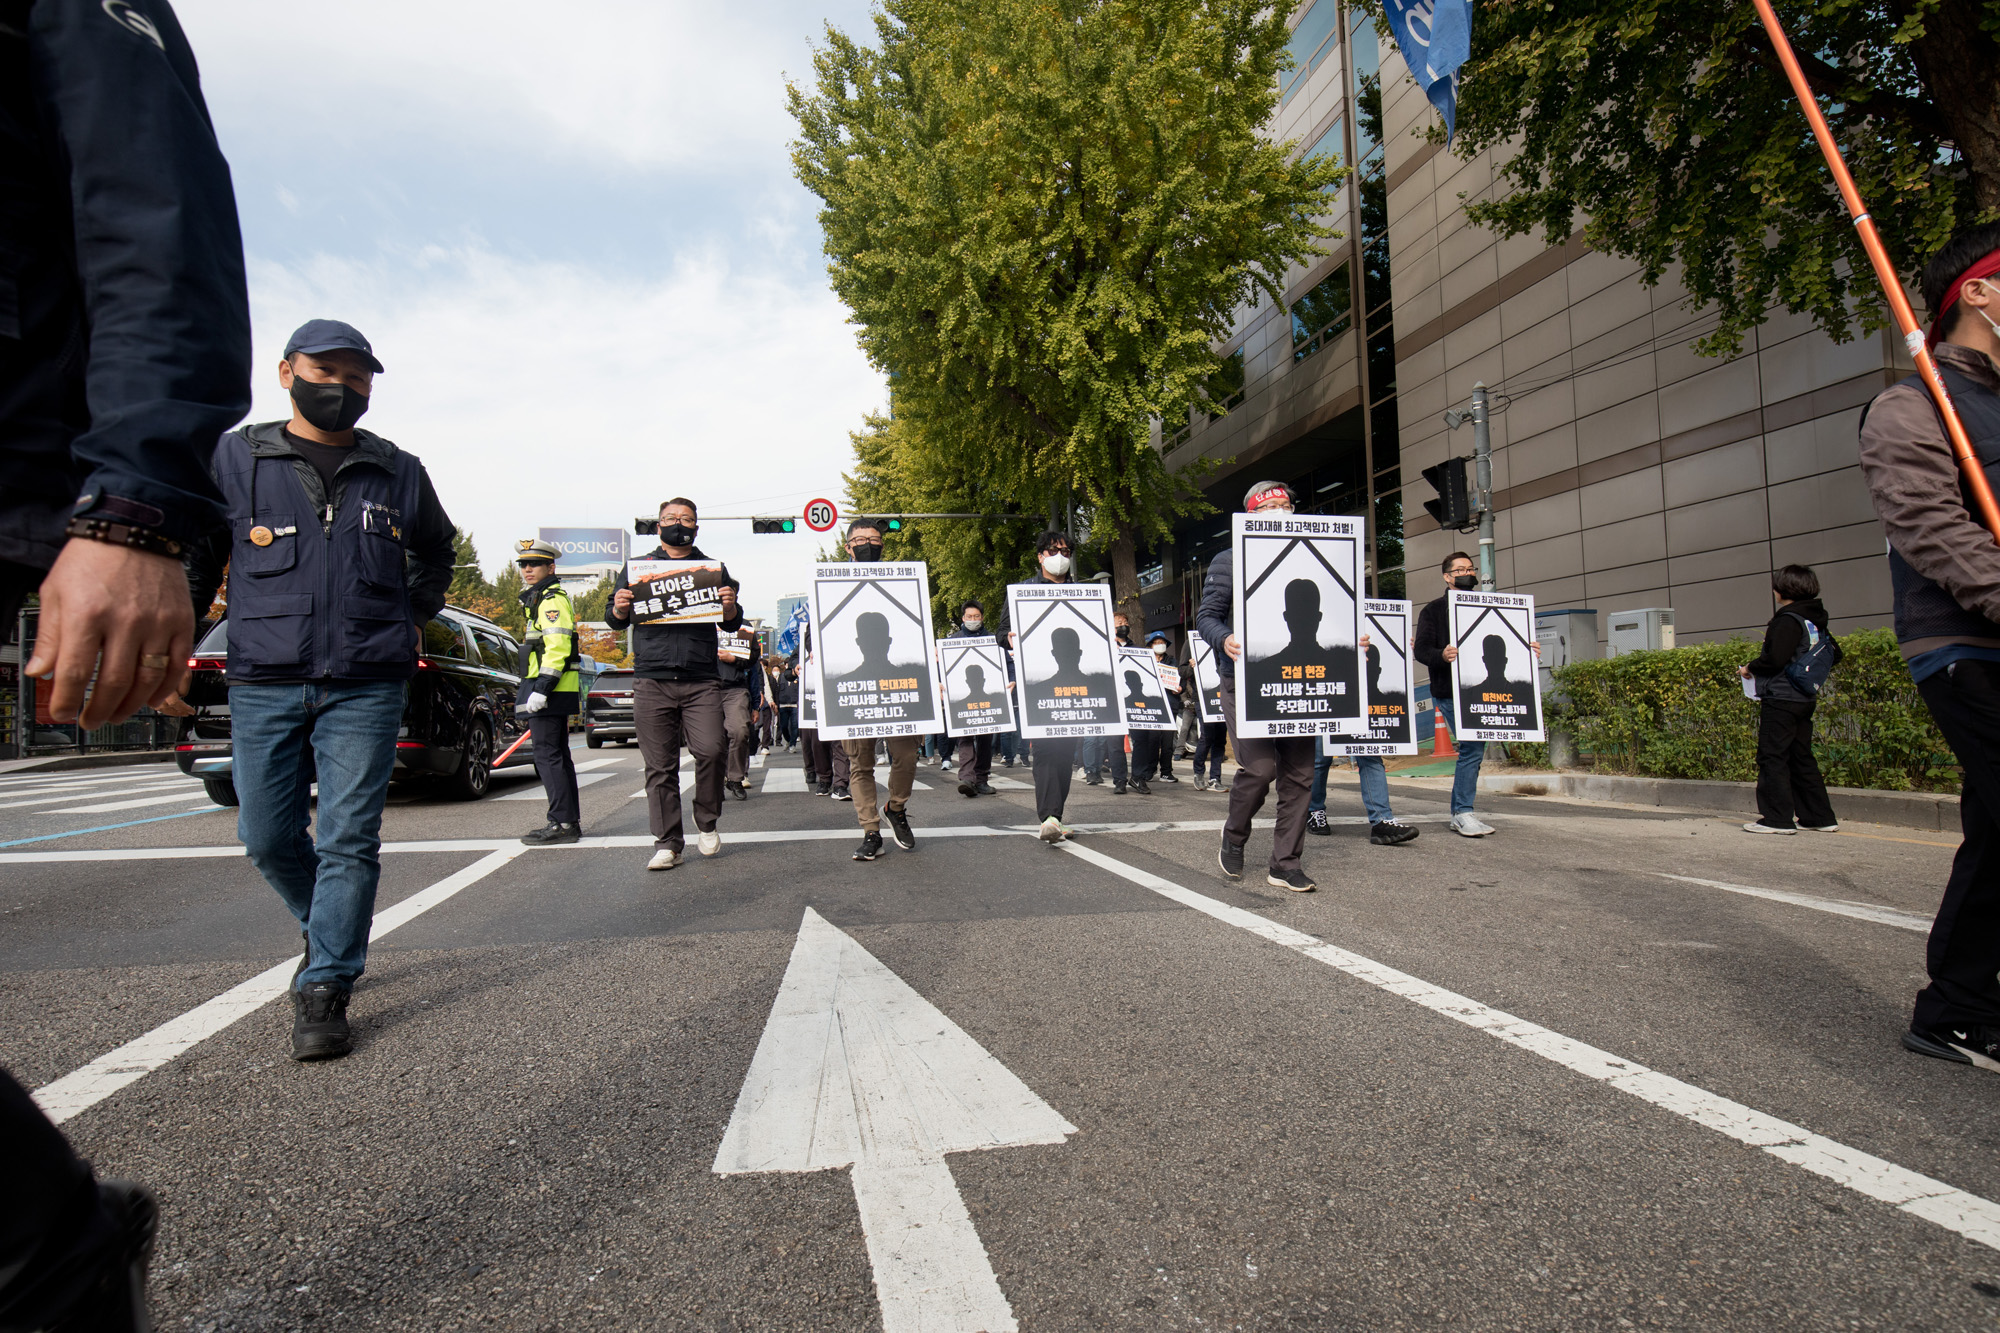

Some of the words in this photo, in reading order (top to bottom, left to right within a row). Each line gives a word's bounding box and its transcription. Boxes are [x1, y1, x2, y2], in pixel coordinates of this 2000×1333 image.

[811, 507, 830, 524] 50
[1245, 520, 1282, 532] 중대재해
[1285, 521, 1330, 533] 최고책임자
[1333, 522, 1354, 534] 처벌!
[816, 568, 850, 577] 중대재해
[853, 567, 894, 577] 최고책임자
[896, 567, 916, 576] 처벌!
[650, 575, 695, 596] 더이상
[1016, 589, 1045, 597] 중대재해
[1047, 589, 1083, 597] 최고책임자
[1085, 589, 1102, 597] 처벌!
[633, 597, 664, 615] 죽을
[666, 594, 682, 609] 수
[684, 586, 720, 606] 없다!
[1456, 594, 1480, 603] 중대재해
[1481, 595, 1511, 605] 최고책임자
[1512, 597, 1527, 606] 처벌!
[720, 639, 729, 647] 수
[1281, 665, 1303, 679] 건설
[1305, 664, 1327, 679] 현장
[836, 680, 877, 693] 살인기업
[878, 677, 918, 691] 현대제철
[1053, 686, 1088, 696] 화일약품
[1260, 683, 1303, 697] 산재사망
[1305, 682, 1346, 696] 노동자를
[838, 694, 878, 707] 산재사망
[880, 691, 920, 705] 노동자를
[1037, 698, 1071, 709] 산재사망
[1073, 697, 1107, 708] 노동자를
[1482, 692, 1513, 702] 여천NCC
[1276, 699, 1332, 713] 추모합니다.
[1389, 705, 1406, 715] SPL
[1469, 703, 1498, 714] 산재사망
[1499, 704, 1528, 715] 노동자를
[854, 706, 907, 719] 추모합니다.
[1051, 710, 1096, 720] 추모합니다.
[1370, 717, 1400, 727] 노동자를
[1480, 715, 1519, 726] 추모합니다.
[847, 726, 873, 737] 철저한
[876, 725, 894, 736] 진상
[896, 724, 917, 734] 규명!
[1045, 727, 1068, 736] 철저한
[1070, 726, 1085, 735] 진상
[1087, 726, 1105, 734] 규명!
[1268, 723, 1296, 735] 철저한
[1298, 722, 1317, 734] 진상
[1320, 722, 1341, 733] 규명!
[1476, 731, 1495, 740] 철저한
[1496, 731, 1509, 740] 진상
[1510, 732, 1526, 740] 규명!
[1345, 745, 1365, 754] 철저한
[1366, 745, 1380, 754] 진상
[1381, 745, 1397, 754] 규명!
